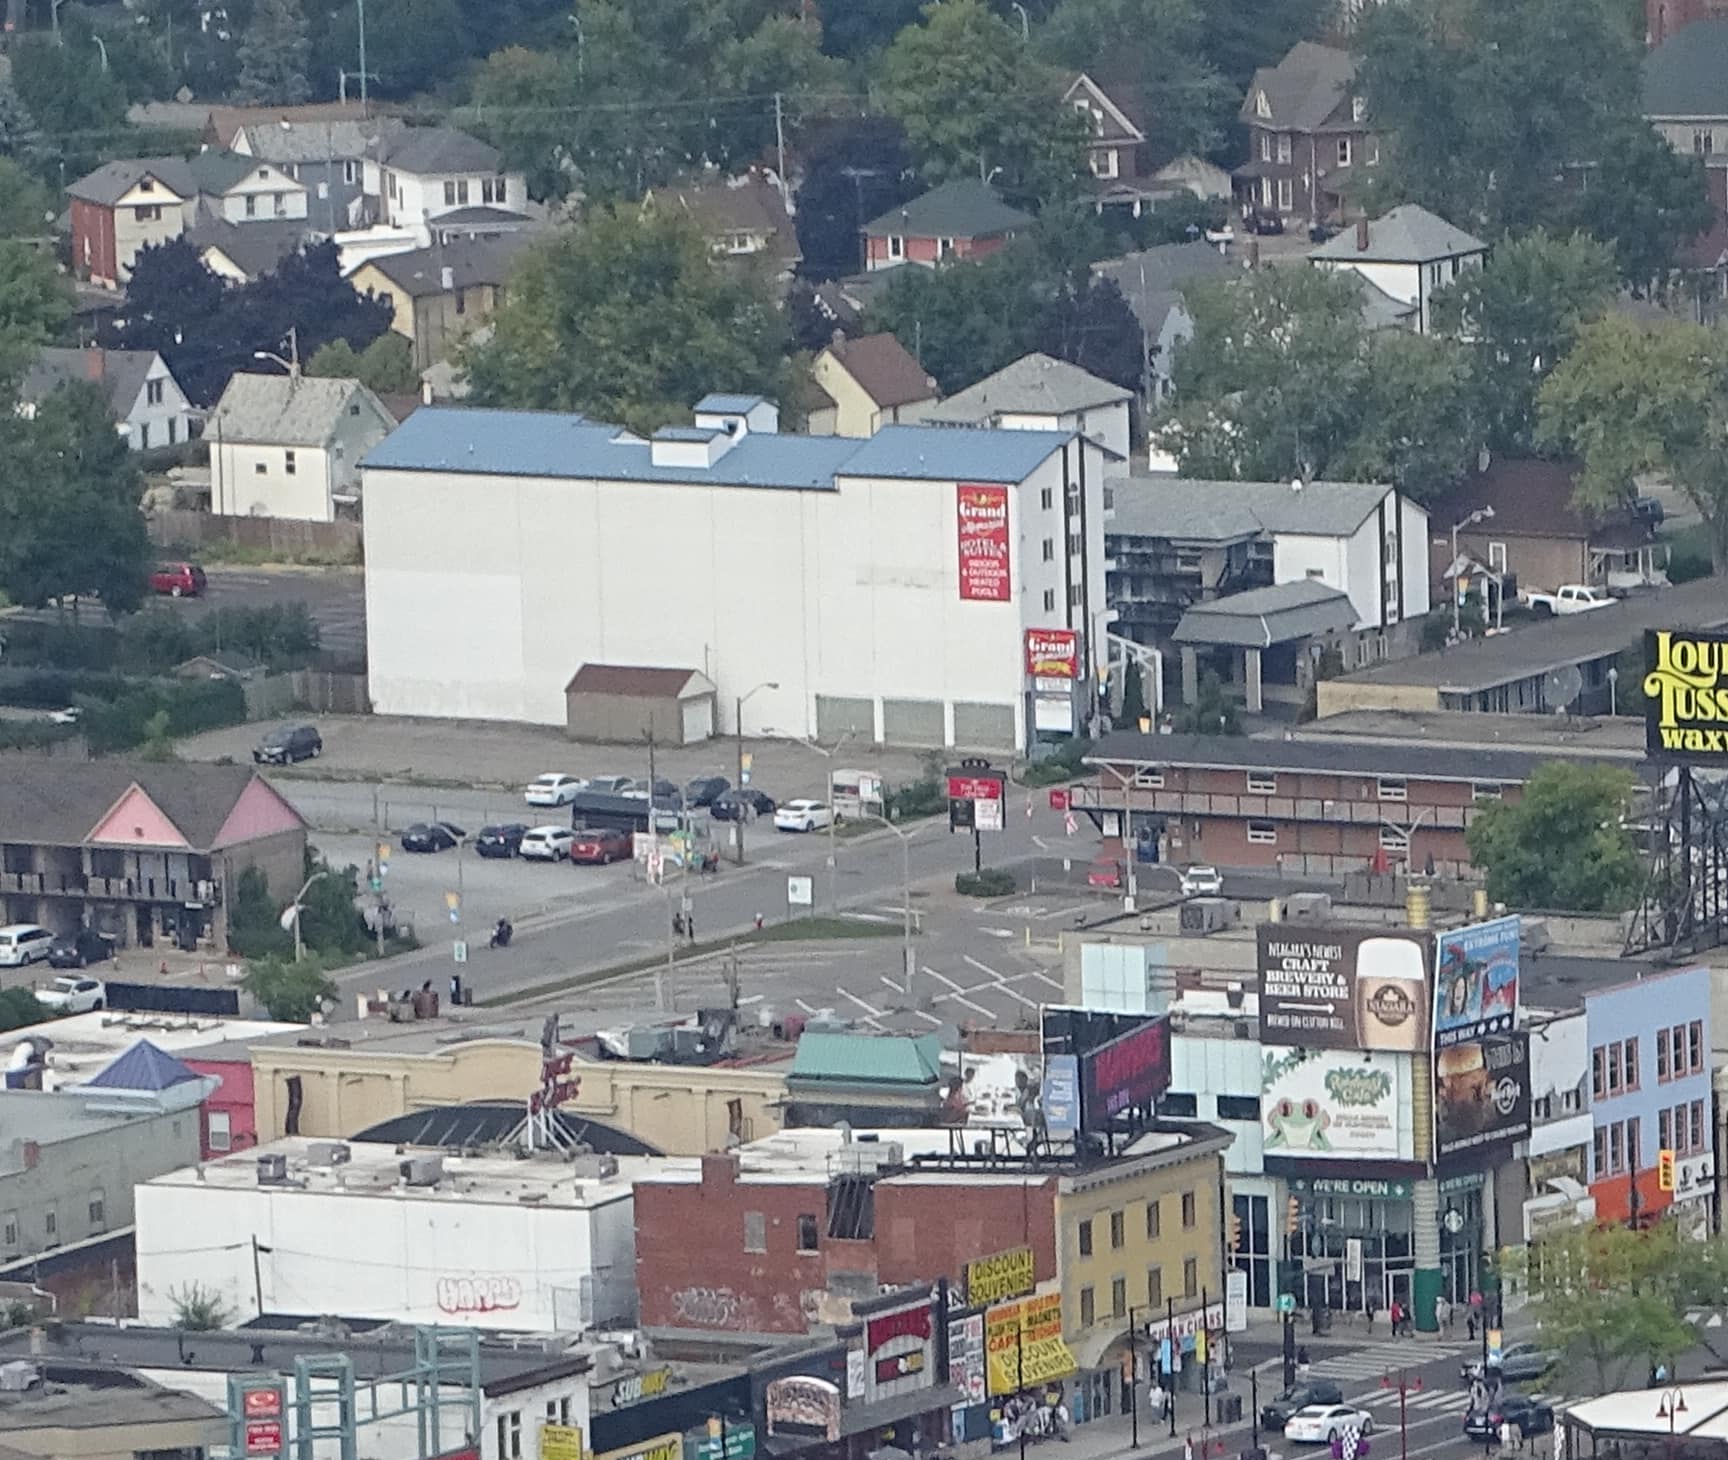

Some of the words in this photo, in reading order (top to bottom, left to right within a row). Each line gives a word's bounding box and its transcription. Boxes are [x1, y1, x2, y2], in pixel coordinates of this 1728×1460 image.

[959, 502, 1006, 519] Grand
[1028, 637, 1077, 656] Grand
[1282, 959, 1331, 972] CRAFT
[1266, 969, 1335, 986] BREWERY
[1337, 974, 1347, 986] &
[1265, 983, 1302, 997] BEER
[1303, 985, 1349, 999] STORE
[1313, 1180, 1350, 1194] WE'RE
[1353, 1181, 1389, 1196] OPEN
[974, 1248, 1033, 1282] DISCOUNT
[967, 1269, 1034, 1302] SOUVENIRS
[1000, 1338, 1064, 1371] DISCOUNT
[612, 1364, 673, 1402] SUBWAY
